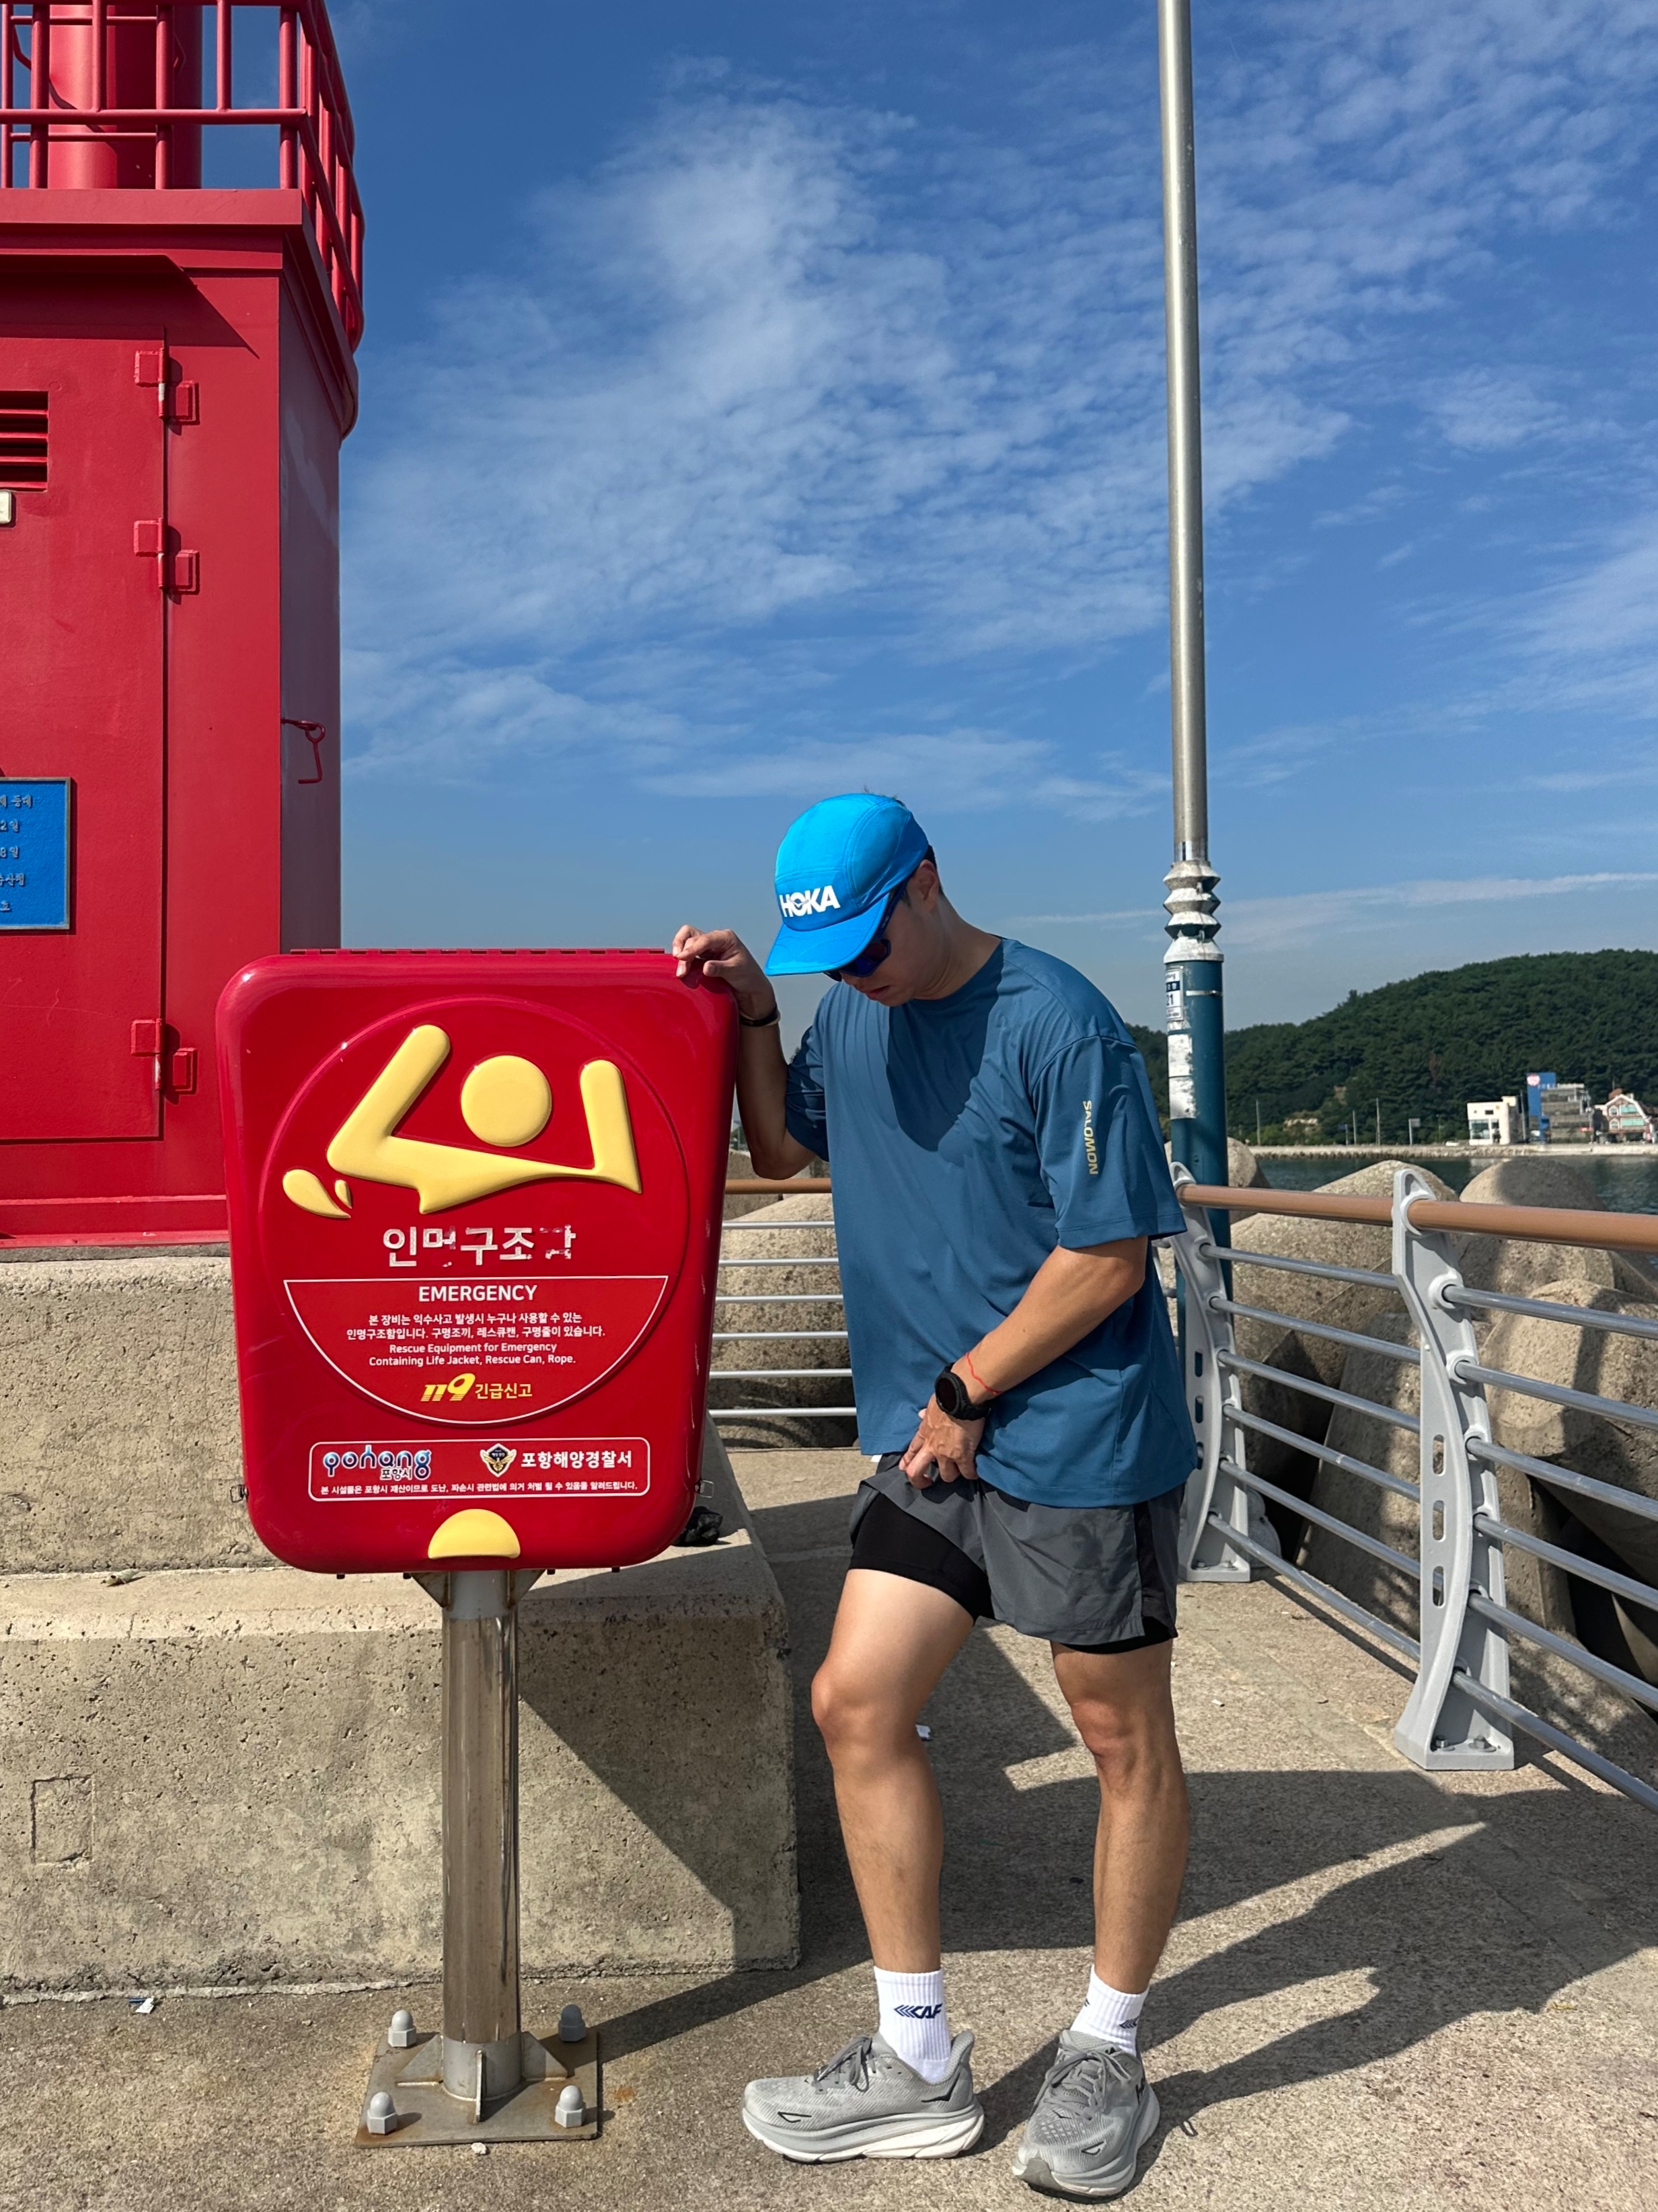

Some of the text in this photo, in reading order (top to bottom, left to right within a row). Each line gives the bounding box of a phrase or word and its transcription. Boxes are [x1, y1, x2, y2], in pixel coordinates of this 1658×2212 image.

[779, 885, 841, 918] HOKA
[1083, 1100, 1099, 1175] SALOMON
[418, 1285, 537, 1302] EMERGENCY
[369, 1313, 582, 1325] 본 장비는 익수사고 발생시 누구나 사용할 수 있는
[347, 1326, 605, 1340] 인명구조함입니다. 구명조끼, 레스큐캔, 구명줄이 있습니다.
[390, 1343, 557, 1354] Rescue Equipment for Emergency
[369, 1354, 575, 1367] Containing Life Jacket, Rescue Can, Rope.
[421, 1373, 532, 1401] 119 긴급신고
[323, 1444, 432, 1480] pohang
[521, 1450, 631, 1469] 포항해양경찰서
[380, 1467, 413, 1481] 포항시
[365, 1485, 387, 1494] 포항시
[391, 1485, 428, 1493] 재산이므로
[431, 1484, 448, 1492] 도난,
[451, 1483, 474, 1491] 파손시
[477, 1483, 506, 1491] 관련법에
[510, 1483, 524, 1491] 의거
[527, 1483, 542, 1491] 처벌
[555, 1482, 563, 1490] 수
[566, 1481, 587, 1490] 있음을
[591, 1481, 637, 1489] 알려드립니다.
